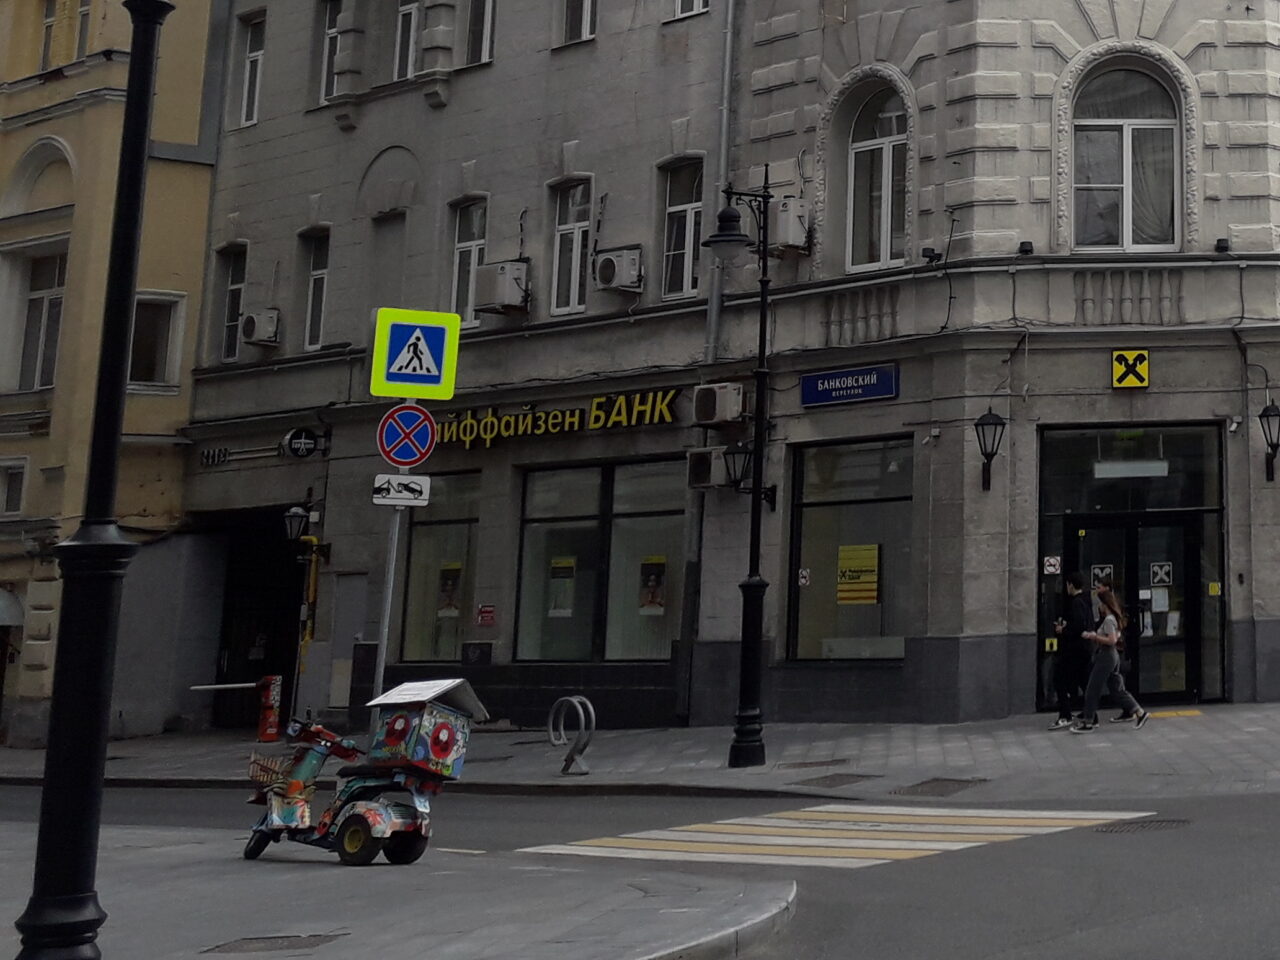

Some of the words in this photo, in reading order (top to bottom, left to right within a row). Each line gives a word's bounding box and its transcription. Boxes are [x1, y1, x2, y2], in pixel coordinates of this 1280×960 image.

[817, 371, 877, 391] БАНКОВСКИЙ
[832, 388, 862, 397] ПЕРЕУЛОК
[436, 404, 580, 450] йффайзен
[588, 389, 677, 430] БАНК
